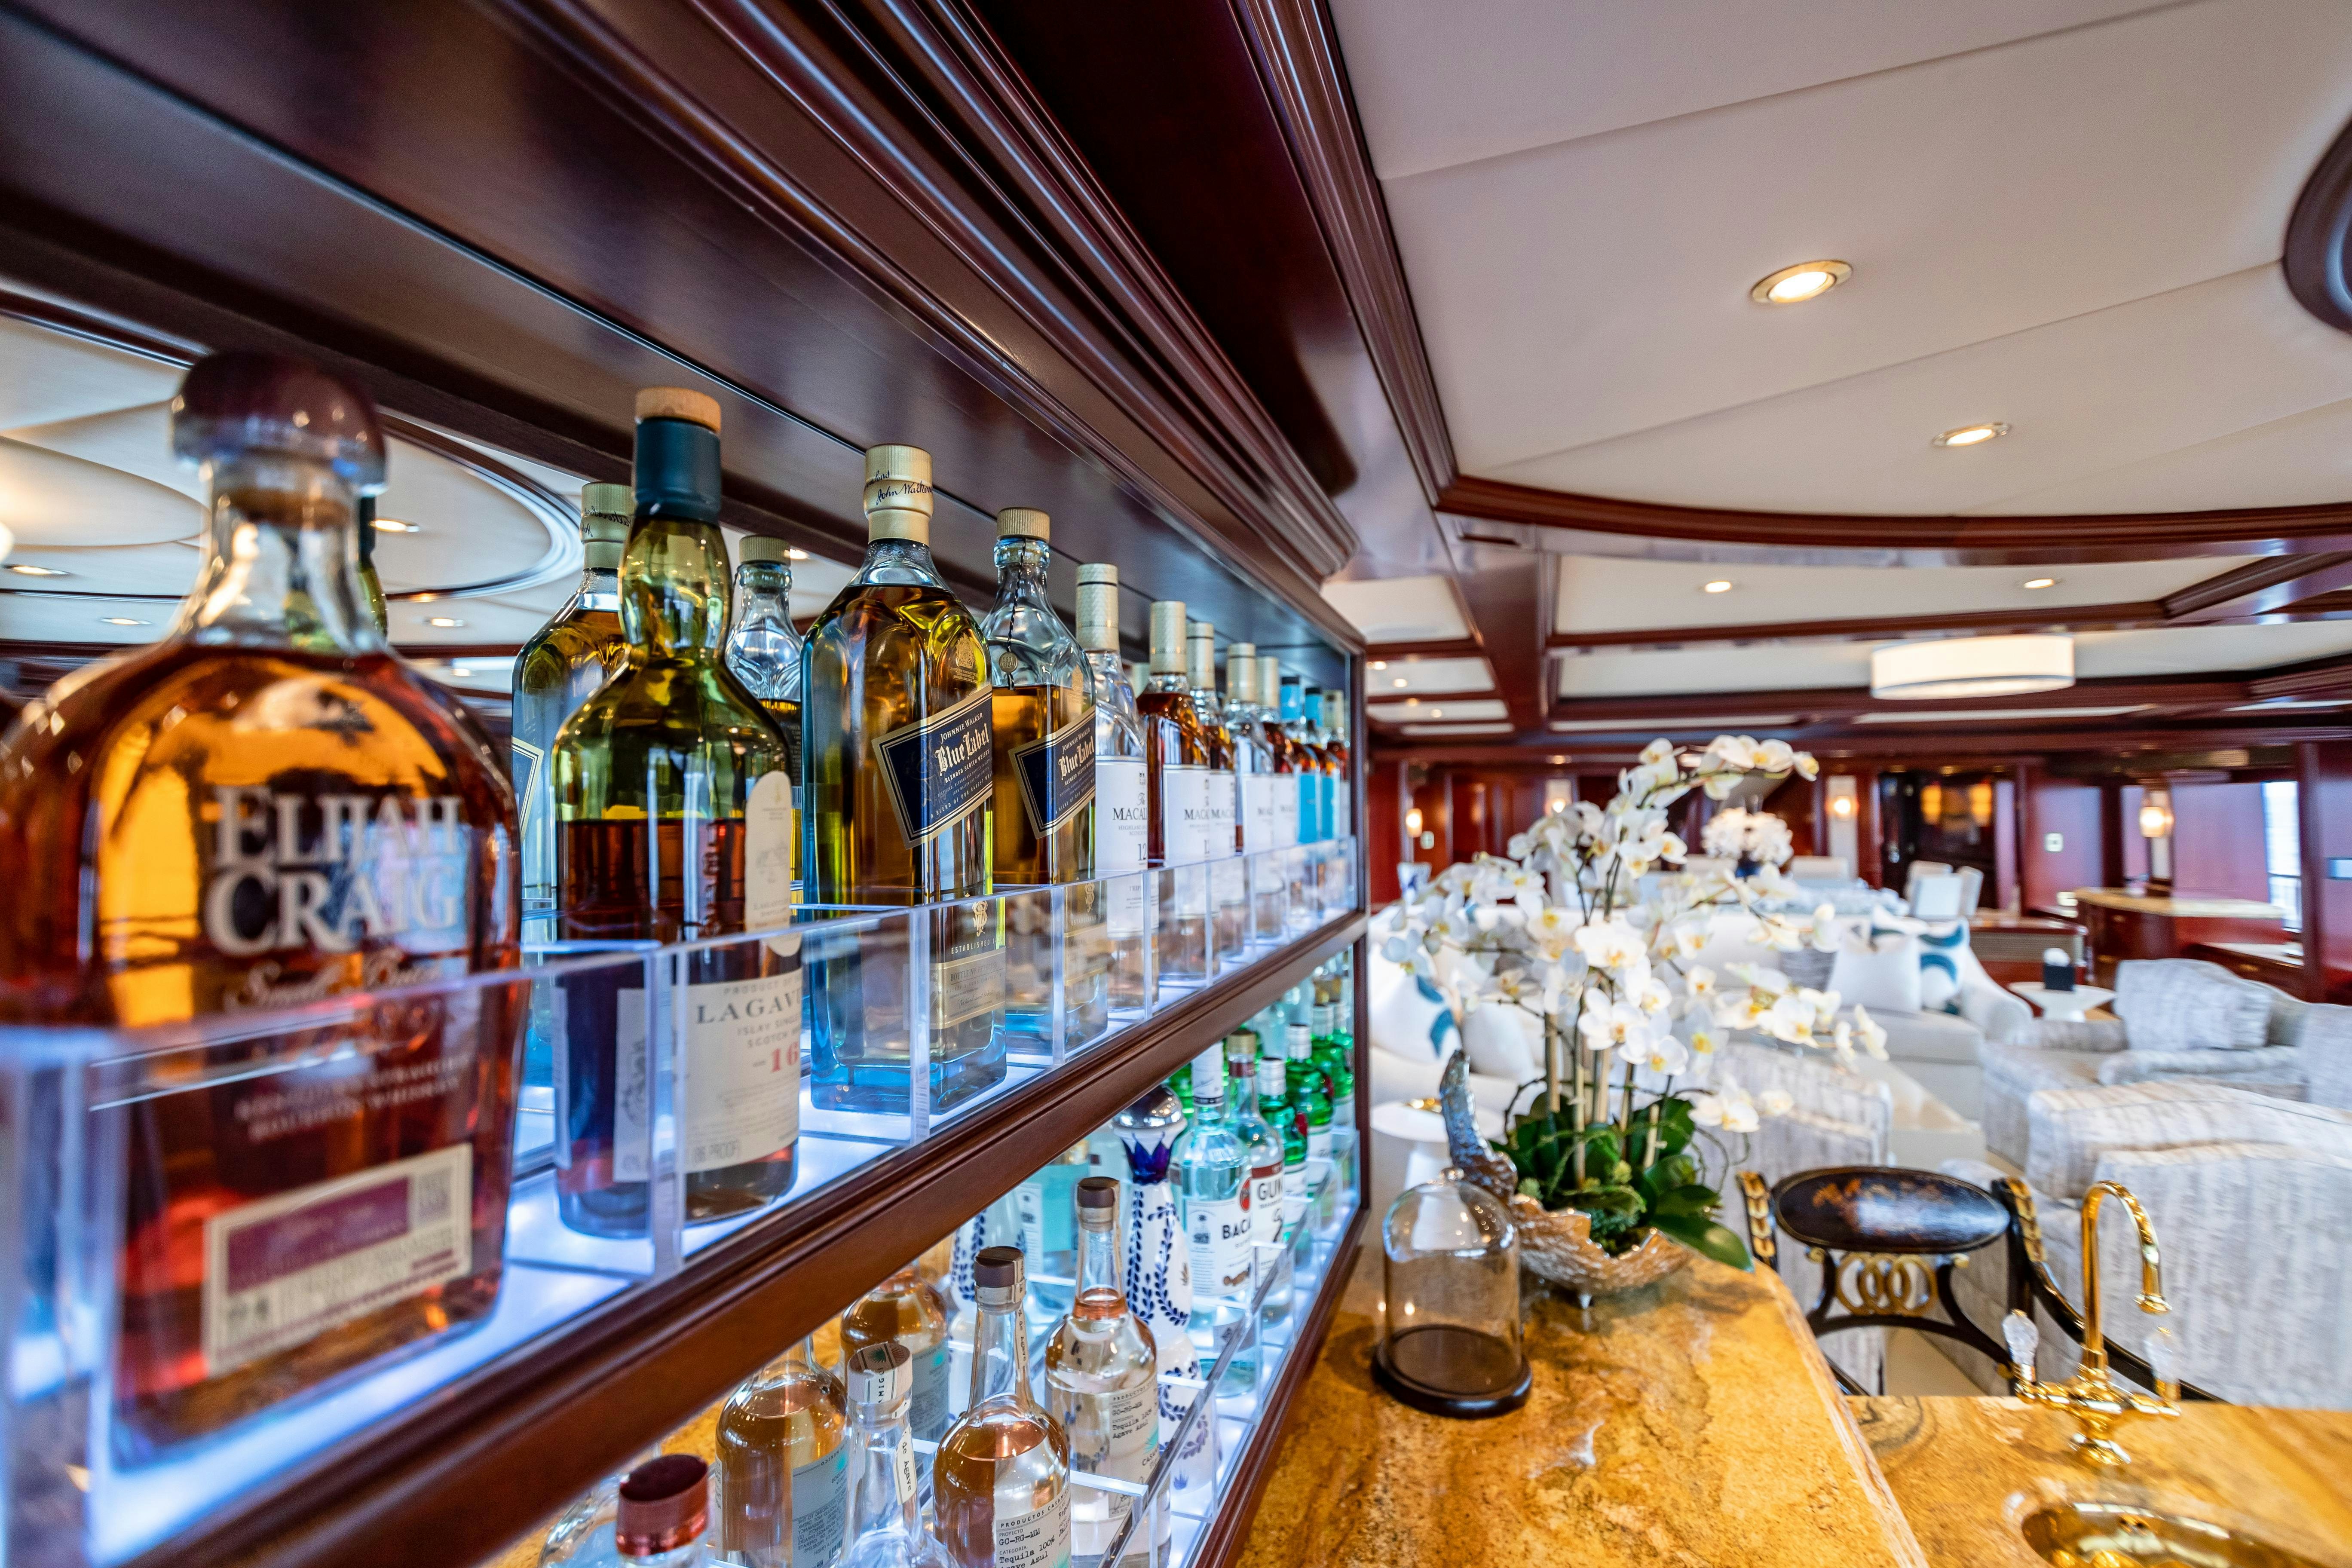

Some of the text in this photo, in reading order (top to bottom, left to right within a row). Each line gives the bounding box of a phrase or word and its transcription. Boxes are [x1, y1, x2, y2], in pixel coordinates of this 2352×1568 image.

[876, 485, 899, 506] John
[940, 712, 983, 744] JOHNNIE WALKER
[1062, 727, 1090, 754] JOHNNIE WALKER
[934, 722, 989, 777] Blue Label
[1058, 735, 1094, 781] Blue Label
[945, 749, 989, 783] BLENDED SCOTCH WHISKY
[1065, 773, 1077, 786] BLENDED
[936, 802, 952, 816] BLEND
[961, 790, 969, 799] OUR
[971, 779, 983, 792] RAREST
[211, 785, 463, 865] ELIJAH
[1138, 843, 1147, 861] 12
[202, 864, 459, 958] CRAIG
[951, 939, 990, 954] ESTABLISHED
[950, 970, 969, 982] BOTTLE
[771, 1041, 799, 1073] 16
[902, 1441, 912, 1492] de Agave
[999, 1528, 1023, 1537] PROYECTO
[1001, 1510, 1044, 1528] PRODUCTOS
[999, 1550, 1035, 1563] Tequila
[1039, 1534, 1055, 1552] 100%
[1030, 1551, 1048, 1565] Azul
